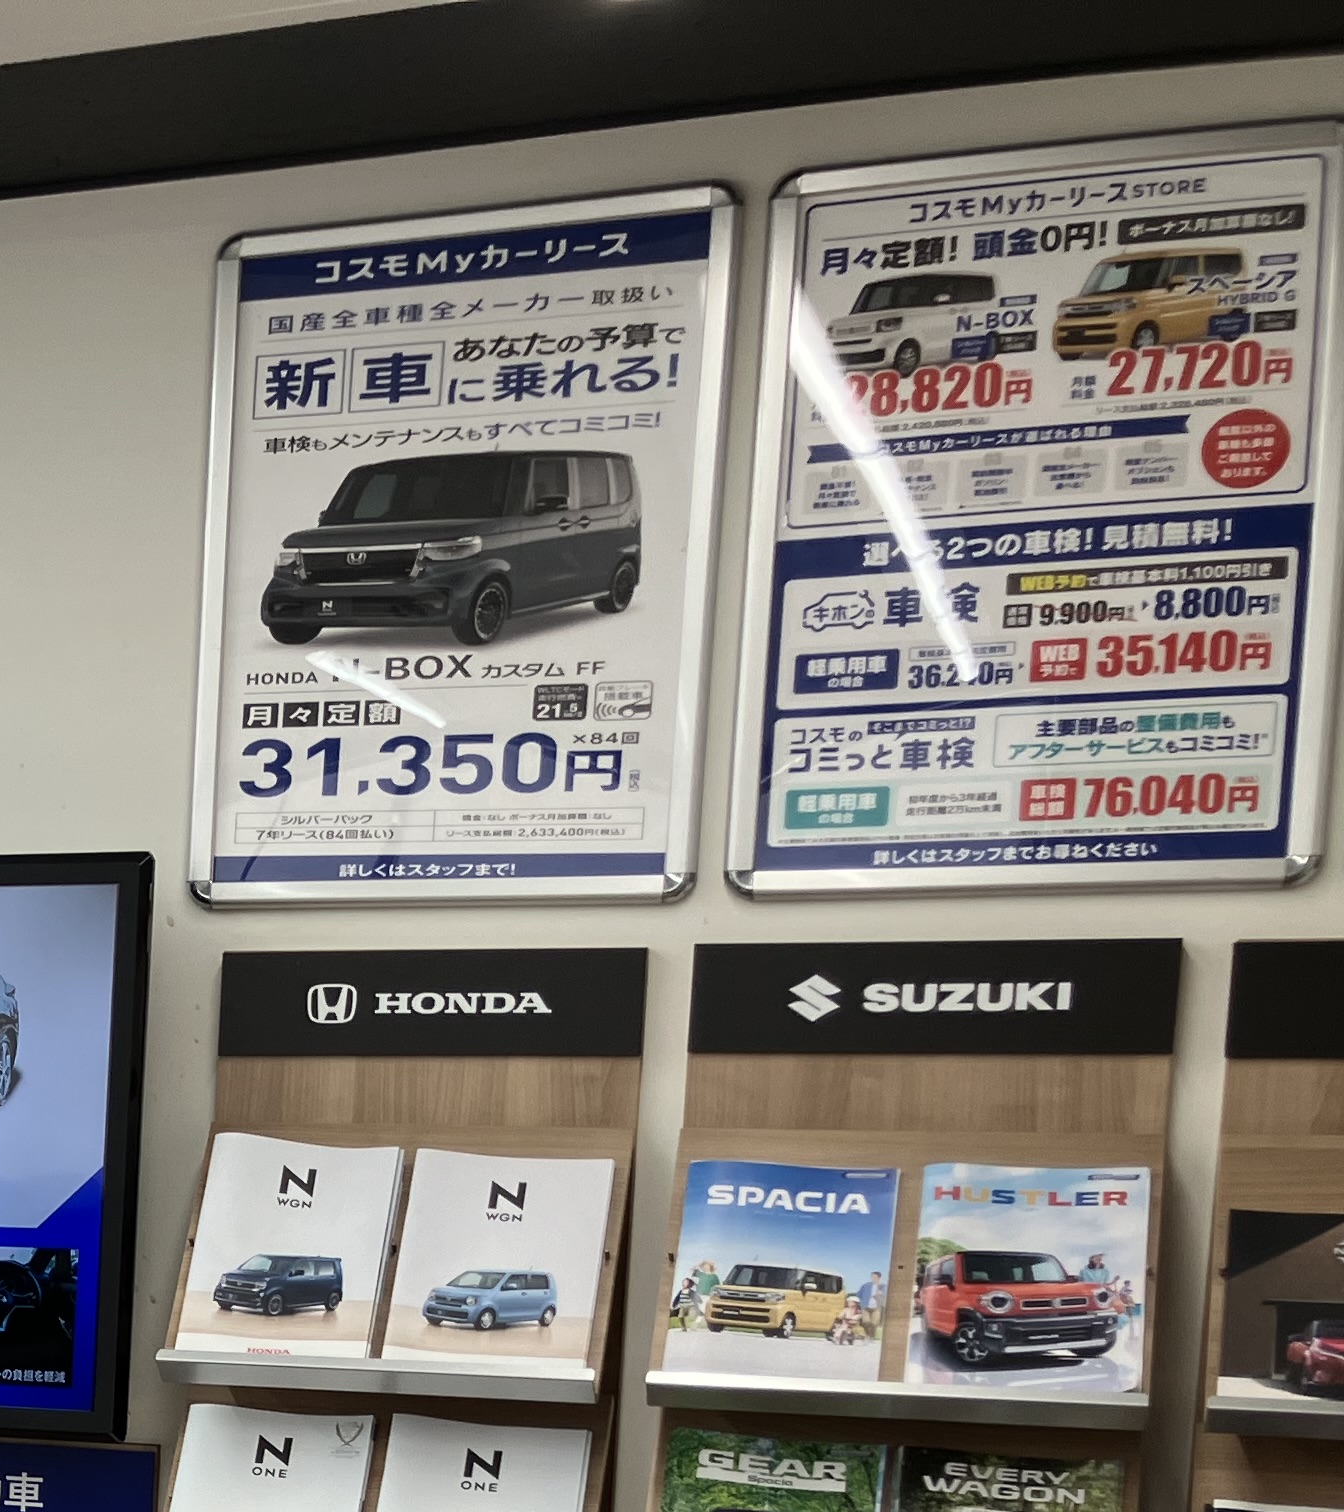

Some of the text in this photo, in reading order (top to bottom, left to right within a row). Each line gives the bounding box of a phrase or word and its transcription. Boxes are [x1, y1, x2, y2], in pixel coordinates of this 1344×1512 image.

[910, 178, 1206, 223] コスモMyカーリースSTORE
[315, 232, 630, 285] コスモMyカーリース
[821, 220, 1108, 276] 月々定額! 頭金0円!
[1188, 270, 1297, 295] スペーシア
[267, 285, 673, 335] 国産全車種全メーカー取扱い
[957, 308, 1034, 332] N-BOX
[453, 322, 686, 363] あなたの予算で
[448, 354, 680, 405] に乗れる!
[1107, 340, 1293, 396] 27,720円
[263, 412, 661, 455] 車検もメンテナンスもすべてコミコミ!
[1039, 645, 1081, 662] WEB
[245, 661, 606, 686] HONDA カスタム FF
[790, 727, 863, 744] コスモの
[239, 732, 622, 797] 31,350円
[788, 737, 975, 773] コミっと車検
[1084, 773, 1259, 818] 76,040円
[339, 863, 516, 878] 詳しくはスタッフまで!
[374, 992, 552, 1015] HONDA
[862, 981, 1072, 1013] SUZUKI
[279, 1165, 317, 1197] N
[488, 1180, 527, 1210] N
[934, 1185, 1128, 1207] HUSTLER
[277, 1197, 312, 1209] WGN
[707, 1184, 871, 1215] SPACIA
[486, 1212, 523, 1223] WGN
[254, 1434, 293, 1466] N
[463, 1448, 503, 1479] N
[697, 1449, 848, 1481] GEAR
[252, 1467, 287, 1479] ONE
[461, 1480, 498, 1492] ONE
[747, 1474, 793, 1488] Spacia
[943, 1462, 1069, 1486] EVERY
[922, 1475, 1086, 1505] WAGON
